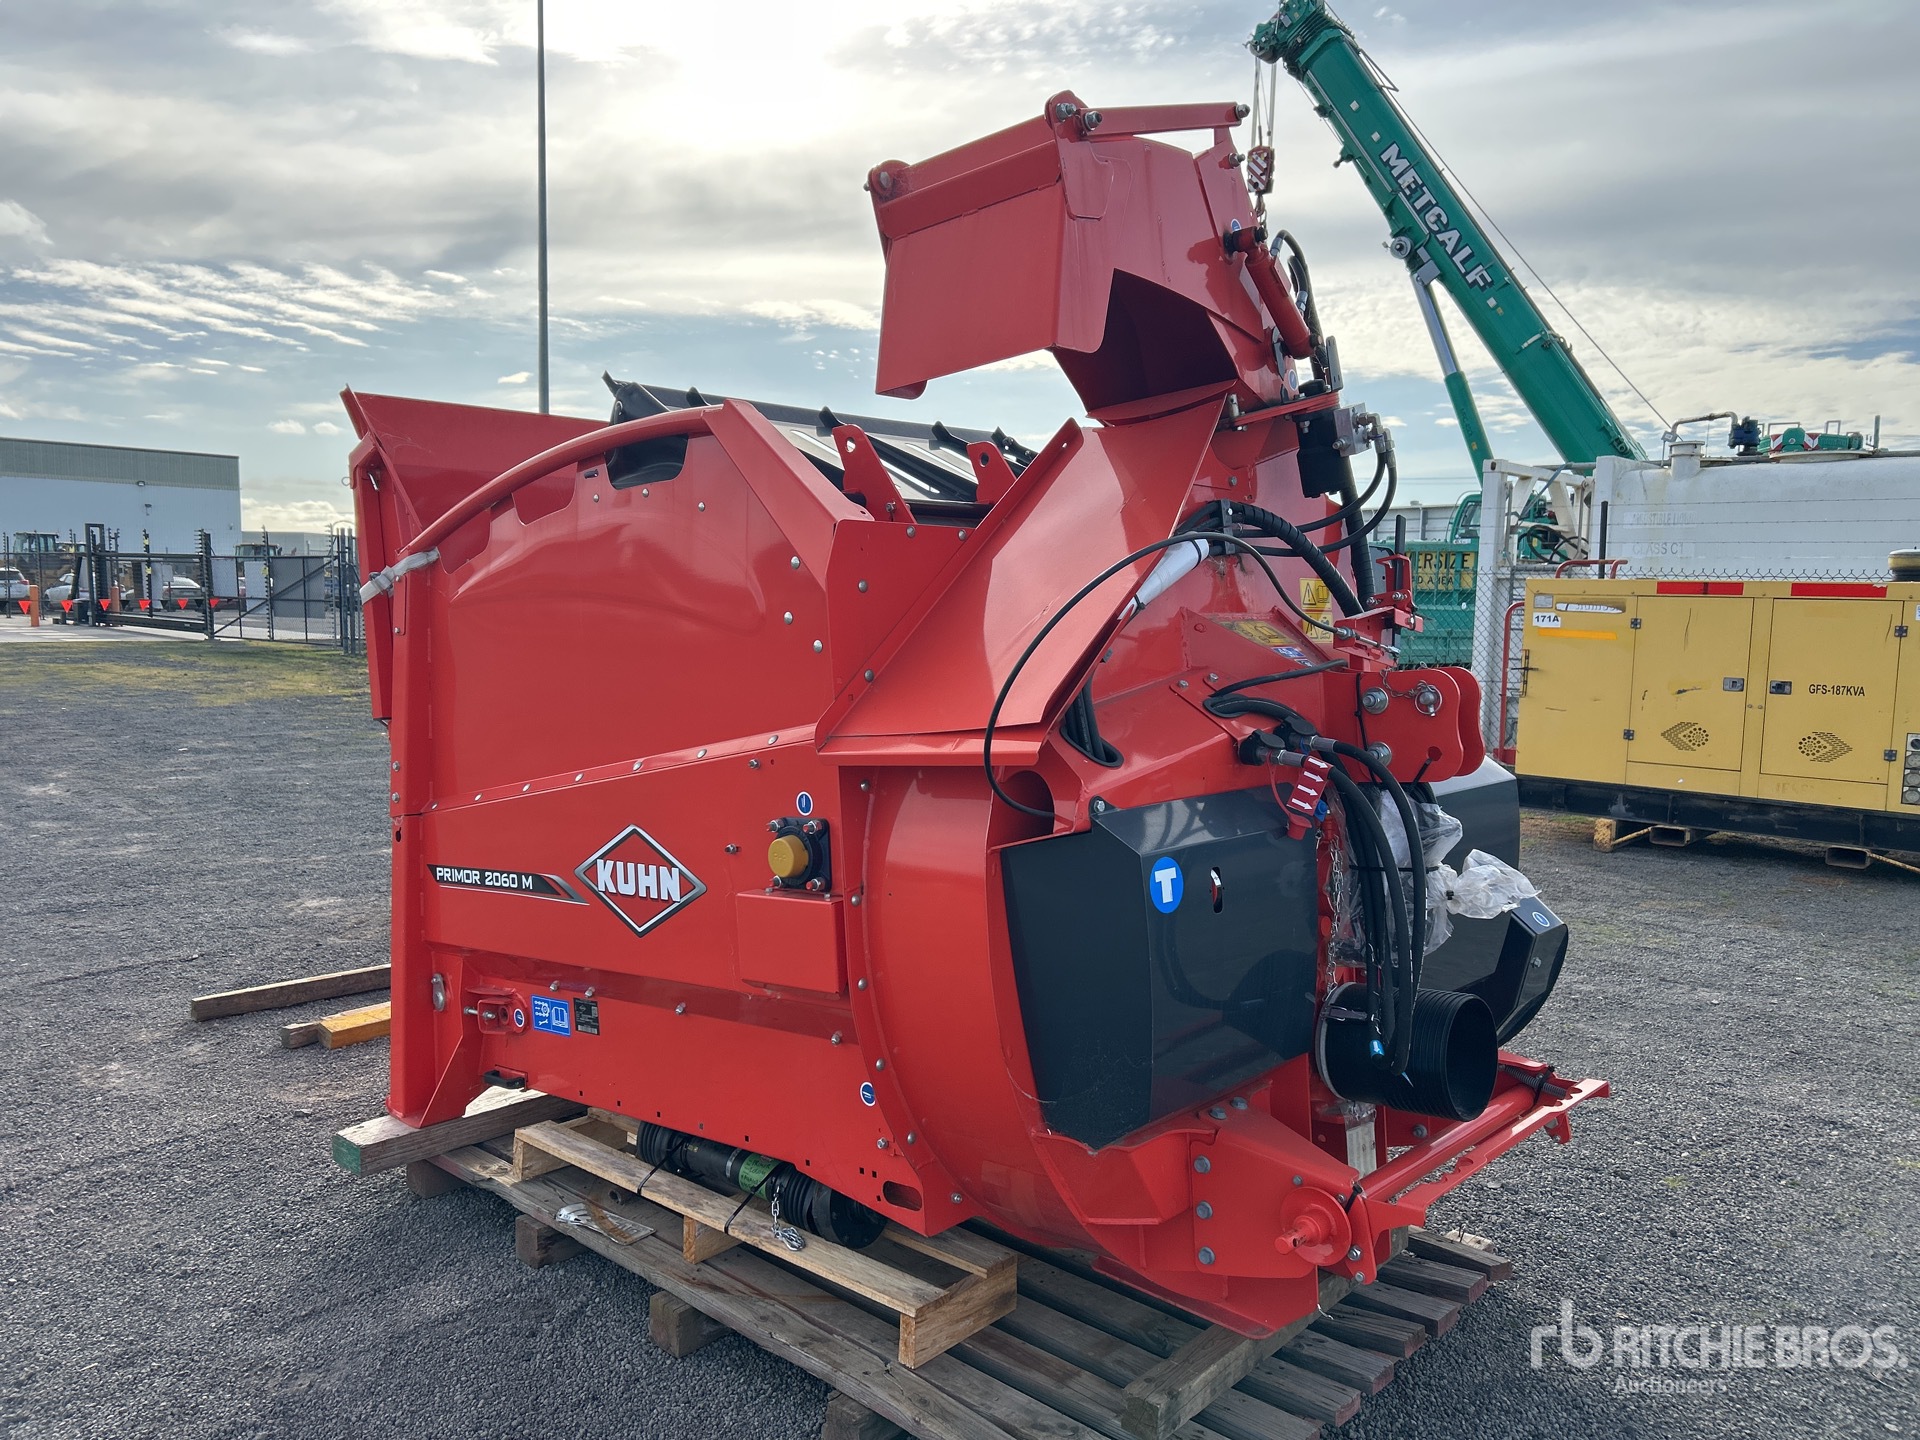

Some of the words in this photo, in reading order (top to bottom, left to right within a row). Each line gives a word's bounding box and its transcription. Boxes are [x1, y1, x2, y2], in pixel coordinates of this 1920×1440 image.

[1380, 142, 1493, 289] METCALF
[1404, 553, 1470, 570] ERSIZE
[1535, 615, 1559, 623] 171A
[1808, 683, 1865, 697] GFS-187KVA
[436, 867, 481, 885] PRIMOR
[485, 871, 518, 888] 2060
[522, 875, 533, 890] M
[597, 859, 681, 902] KUHN
[1154, 867, 1177, 904] T
